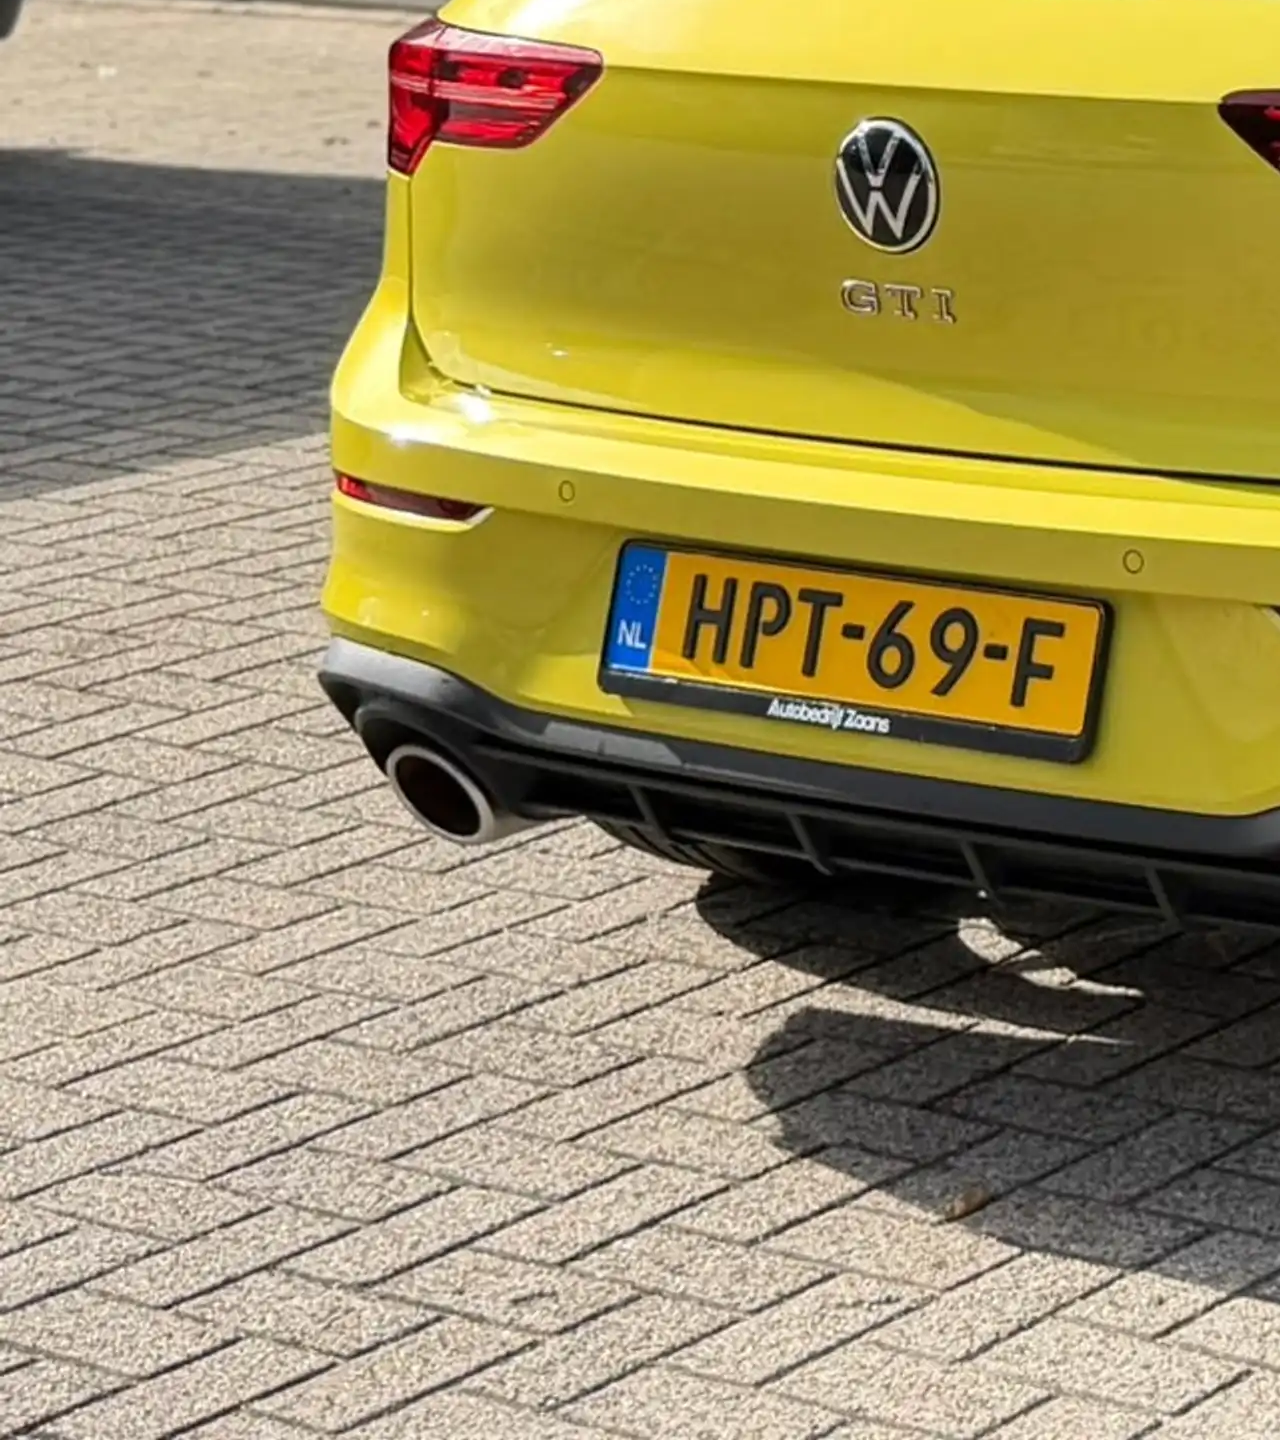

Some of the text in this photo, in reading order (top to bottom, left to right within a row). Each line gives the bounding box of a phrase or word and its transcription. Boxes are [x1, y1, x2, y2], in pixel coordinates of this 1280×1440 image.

[840, 278, 957, 324] GTI
[617, 621, 647, 649] NL
[682, 572, 1066, 708] HPT-69-F
[766, 698, 845, 730] Autobedrijf
